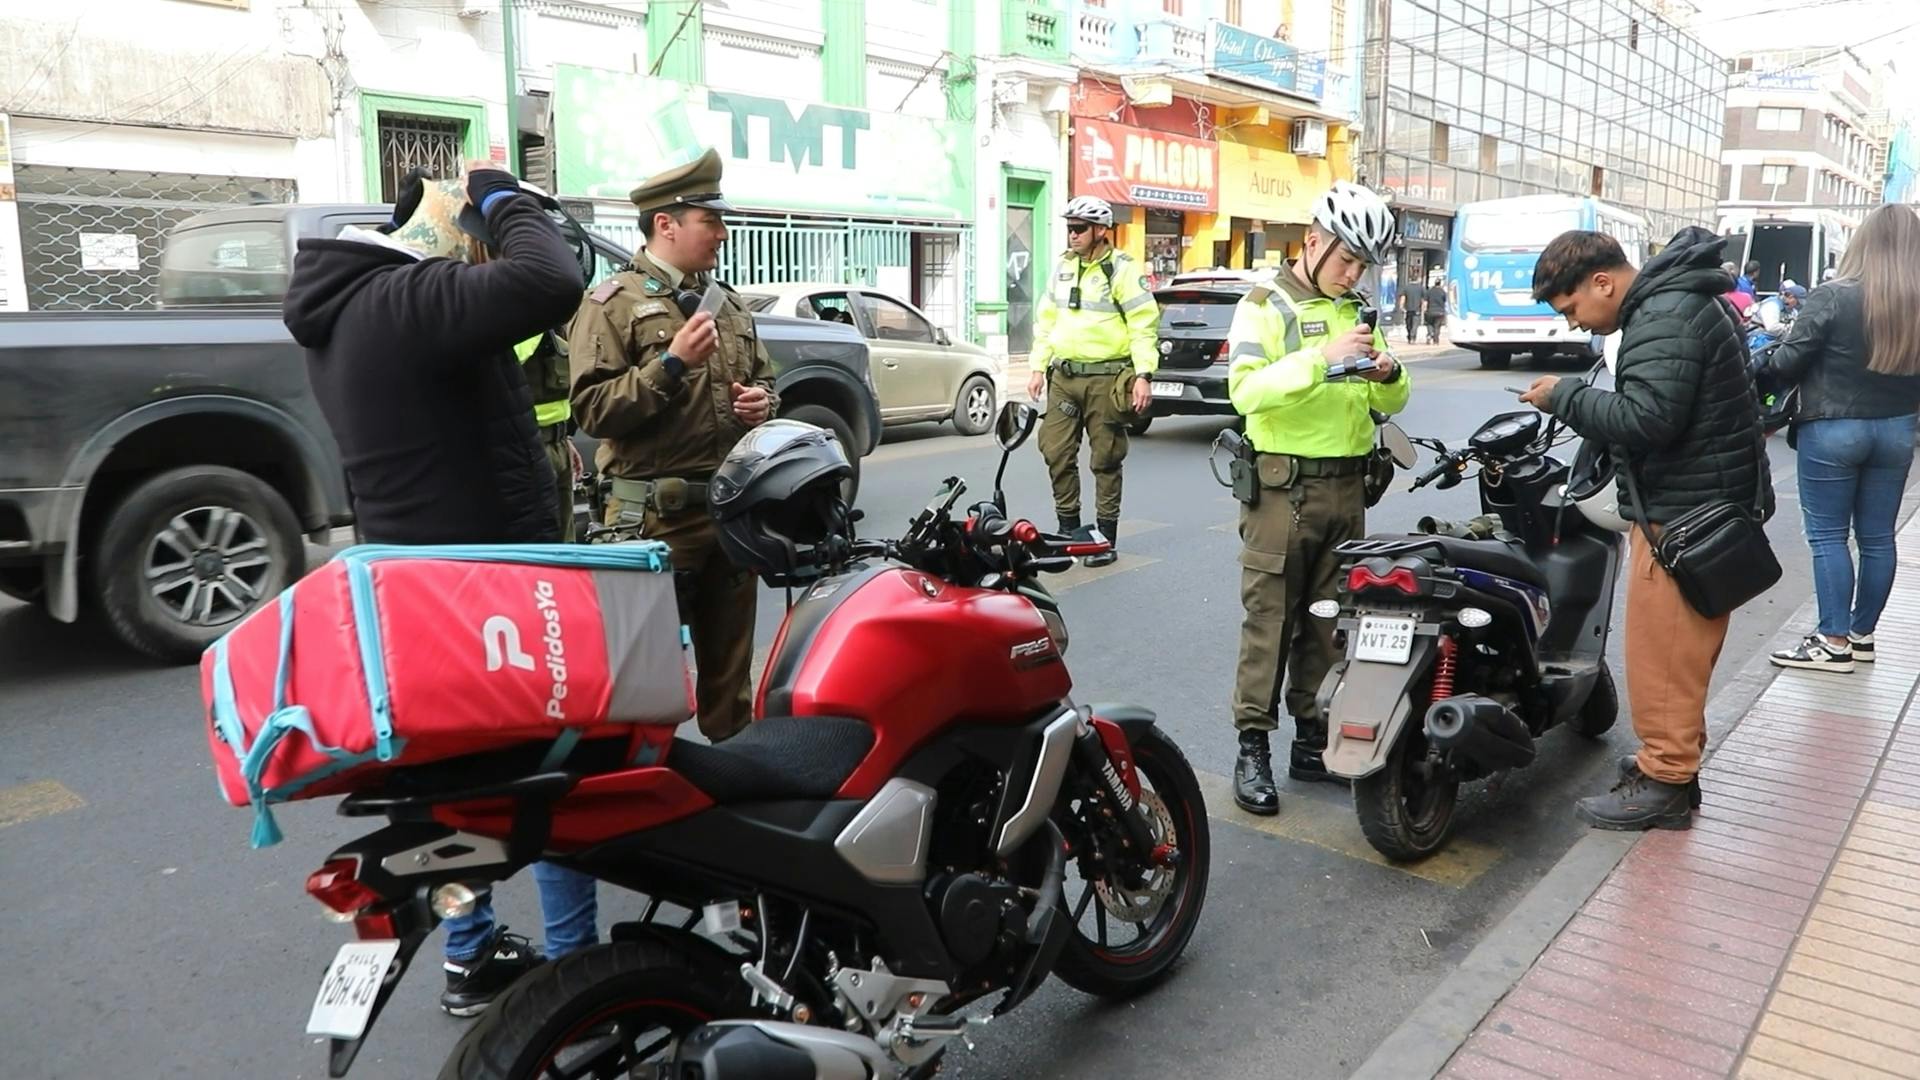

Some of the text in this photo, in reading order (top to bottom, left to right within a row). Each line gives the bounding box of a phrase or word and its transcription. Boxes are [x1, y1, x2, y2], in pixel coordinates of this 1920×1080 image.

[708, 90, 871, 174] TMT
[1124, 133, 1214, 190] PALGON
[1249, 171, 1292, 198] Aurus
[1470, 270, 1503, 290] 114
[534, 579, 568, 720] PedidosYa
[1373, 622, 1400, 630] CHILE
[1102, 758, 1133, 812] YAMAHA
